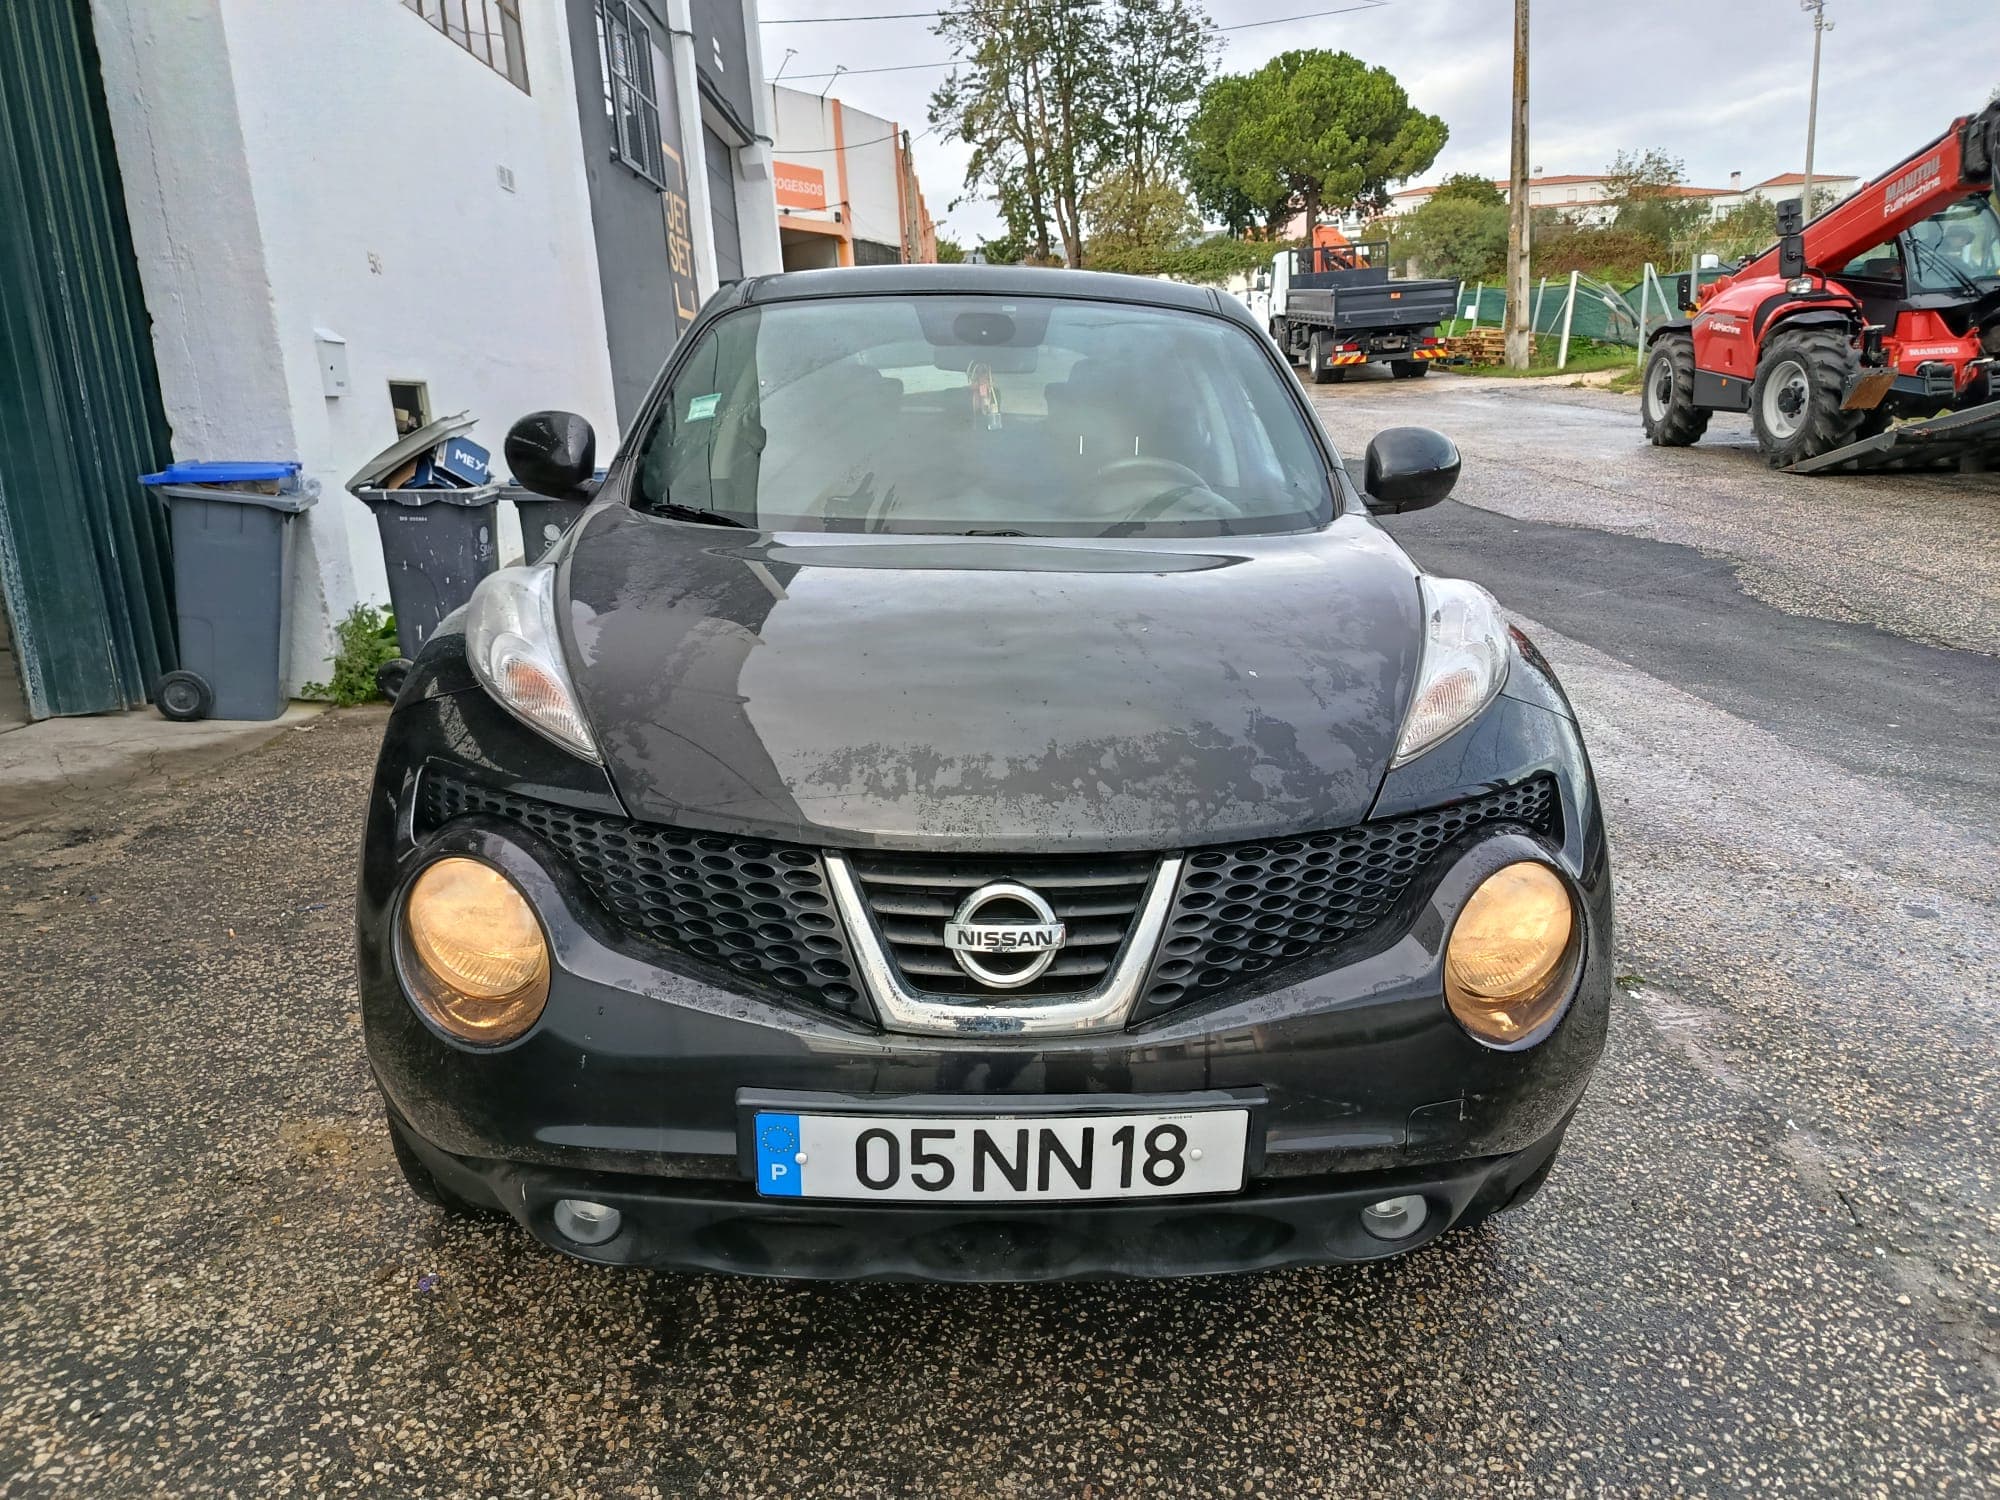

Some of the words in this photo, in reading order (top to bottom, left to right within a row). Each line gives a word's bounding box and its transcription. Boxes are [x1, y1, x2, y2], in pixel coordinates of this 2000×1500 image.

[1885, 155, 1940, 204] MANITOU
[667, 190, 688, 239] JET
[669, 231, 692, 280] SET
[957, 930, 1053, 947] NISSAN
[770, 1163, 788, 1181] P
